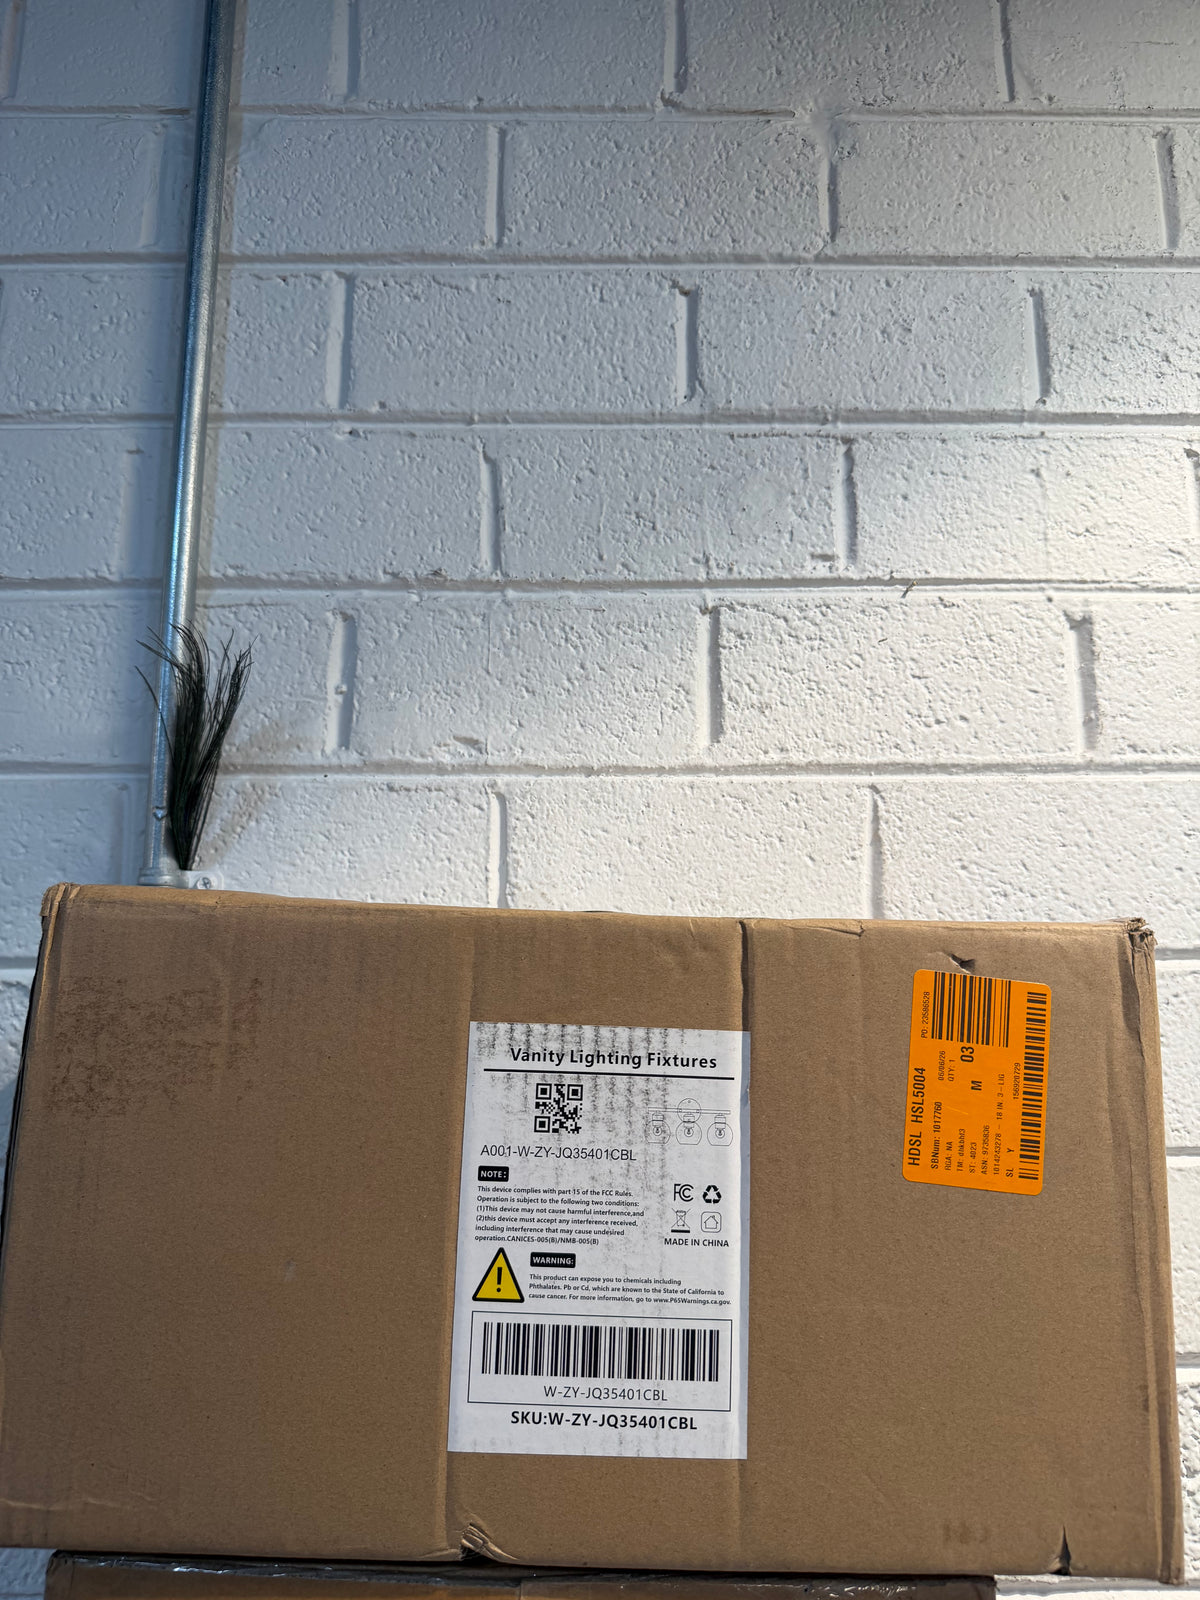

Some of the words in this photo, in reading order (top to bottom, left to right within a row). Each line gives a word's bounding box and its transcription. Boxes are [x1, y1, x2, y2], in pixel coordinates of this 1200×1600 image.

[922, 992, 930, 1025] 23586528
[510, 1048, 565, 1066] Vanity
[570, 1050, 642, 1069] Lighting
[647, 1052, 717, 1068] Fixtures
[961, 1046, 975, 1063] 03
[938, 1051, 946, 1081] 06/06/26
[971, 1080, 982, 1091] M
[911, 1067, 925, 1123] HSL5004
[933, 1102, 942, 1133] 1017760
[997, 1112, 1002, 1120] 18
[480, 1145, 637, 1161] A001-W-ZY-JQ35401CBL
[908, 1131, 922, 1166] HDSL
[931, 1136, 940, 1169] SBNum:
[947, 1141, 952, 1151] NA
[480, 1170, 507, 1178] NOTE:
[1006, 1167, 1014, 1178] SL
[561, 1198, 590, 1206] following
[593, 1209, 644, 1217] interference,and
[664, 1238, 688, 1246] MADE
[703, 1239, 729, 1247] CHINA
[654, 1278, 681, 1286] including
[544, 1386, 668, 1401] W-ZY-JQ35401CBL
[511, 1411, 698, 1430] SKU:W-ZY-JQ35401CBL
